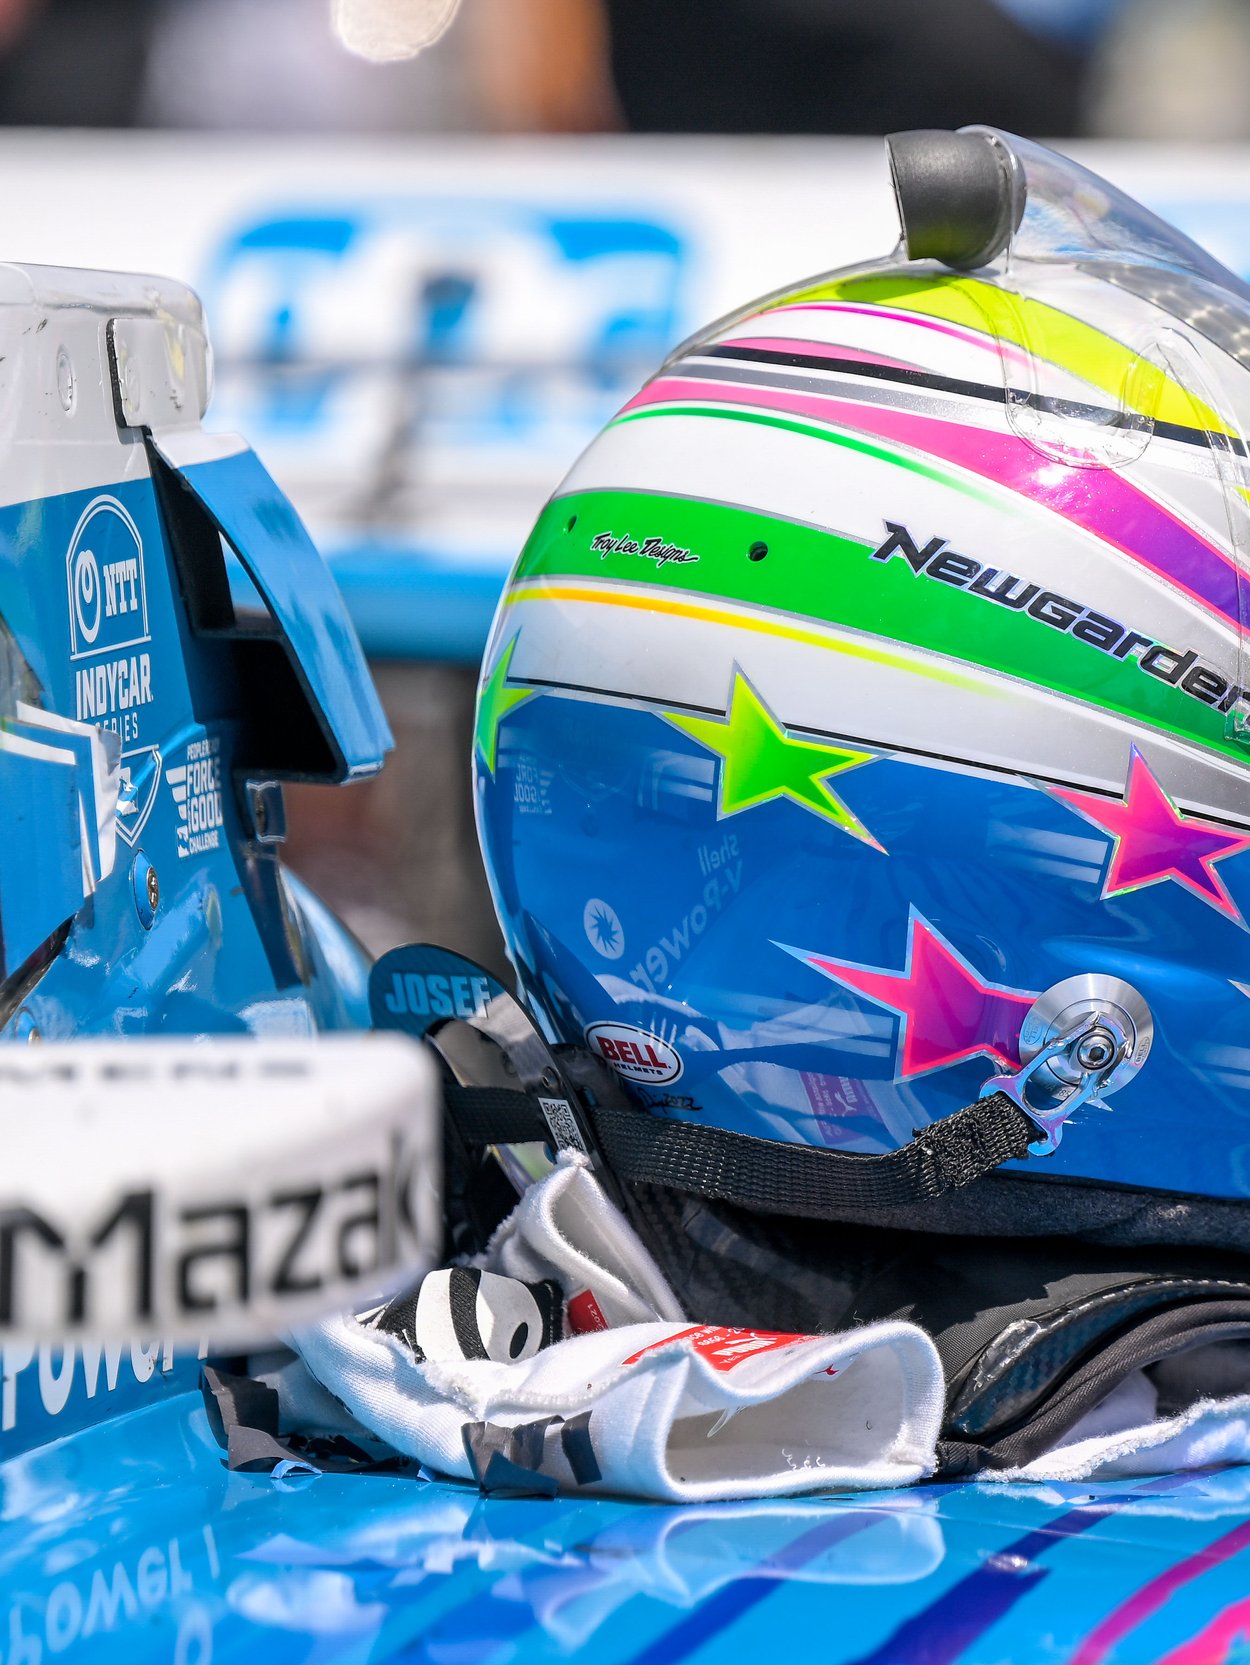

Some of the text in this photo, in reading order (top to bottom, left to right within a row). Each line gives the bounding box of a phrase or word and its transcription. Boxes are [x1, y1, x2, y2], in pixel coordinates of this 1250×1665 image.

[591, 532, 699, 567] Troy Lee Designs
[103, 558, 138, 617] NTT
[76, 653, 152, 720] INDYCAR
[95, 712, 138, 746] RIES
[385, 973, 491, 1018] JOSEF
[596, 1036, 667, 1069] BELL
[614, 1062, 663, 1075] HELMETS
